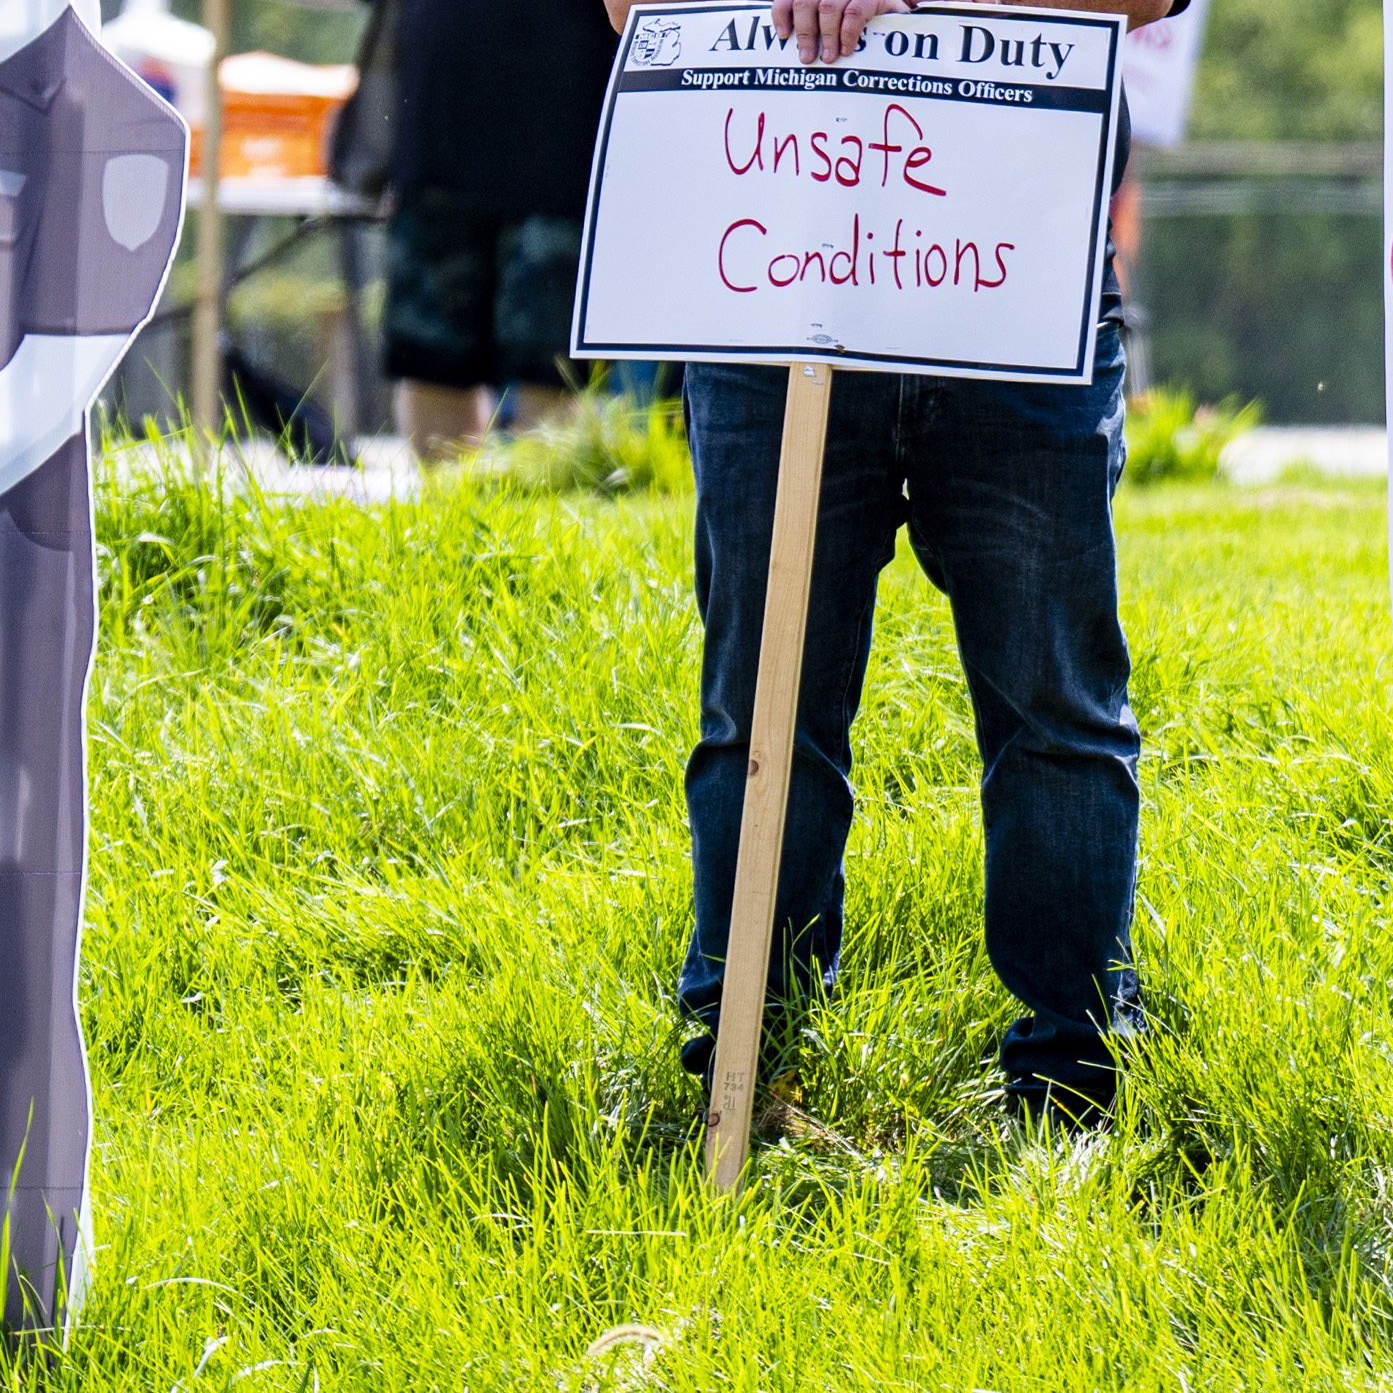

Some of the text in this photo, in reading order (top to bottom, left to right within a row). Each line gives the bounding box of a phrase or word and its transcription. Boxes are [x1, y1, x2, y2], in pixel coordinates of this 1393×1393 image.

[681, 68, 1033, 104] Support Michigan Corrections Officers
[884, 28, 939, 61] on
[956, 24, 1075, 81] Duty
[724, 103, 947, 196] Unsafe
[718, 212, 1016, 294] Conditions
